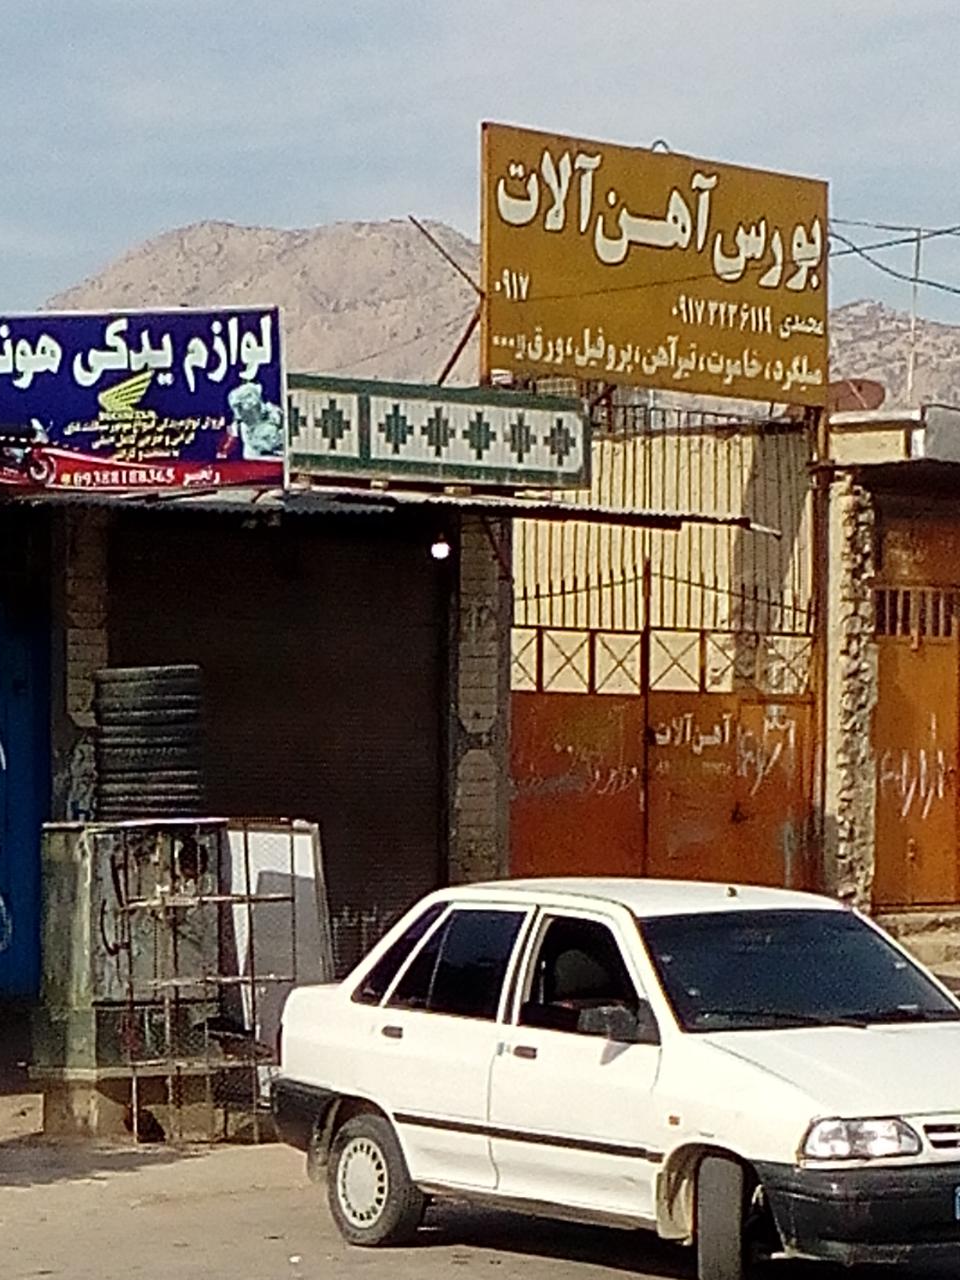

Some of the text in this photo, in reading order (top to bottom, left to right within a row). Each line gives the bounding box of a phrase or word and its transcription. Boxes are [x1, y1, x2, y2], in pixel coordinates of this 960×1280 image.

[496, 150, 823, 291] بورس آهن آلات
[494, 268, 530, 300] ۰۹۱۷
[73, 317, 174, 387] یدکی
[183, 314, 273, 393] لوازم
[779, 314, 824, 339] محمدی
[691, 712, 734, 756] آهن
